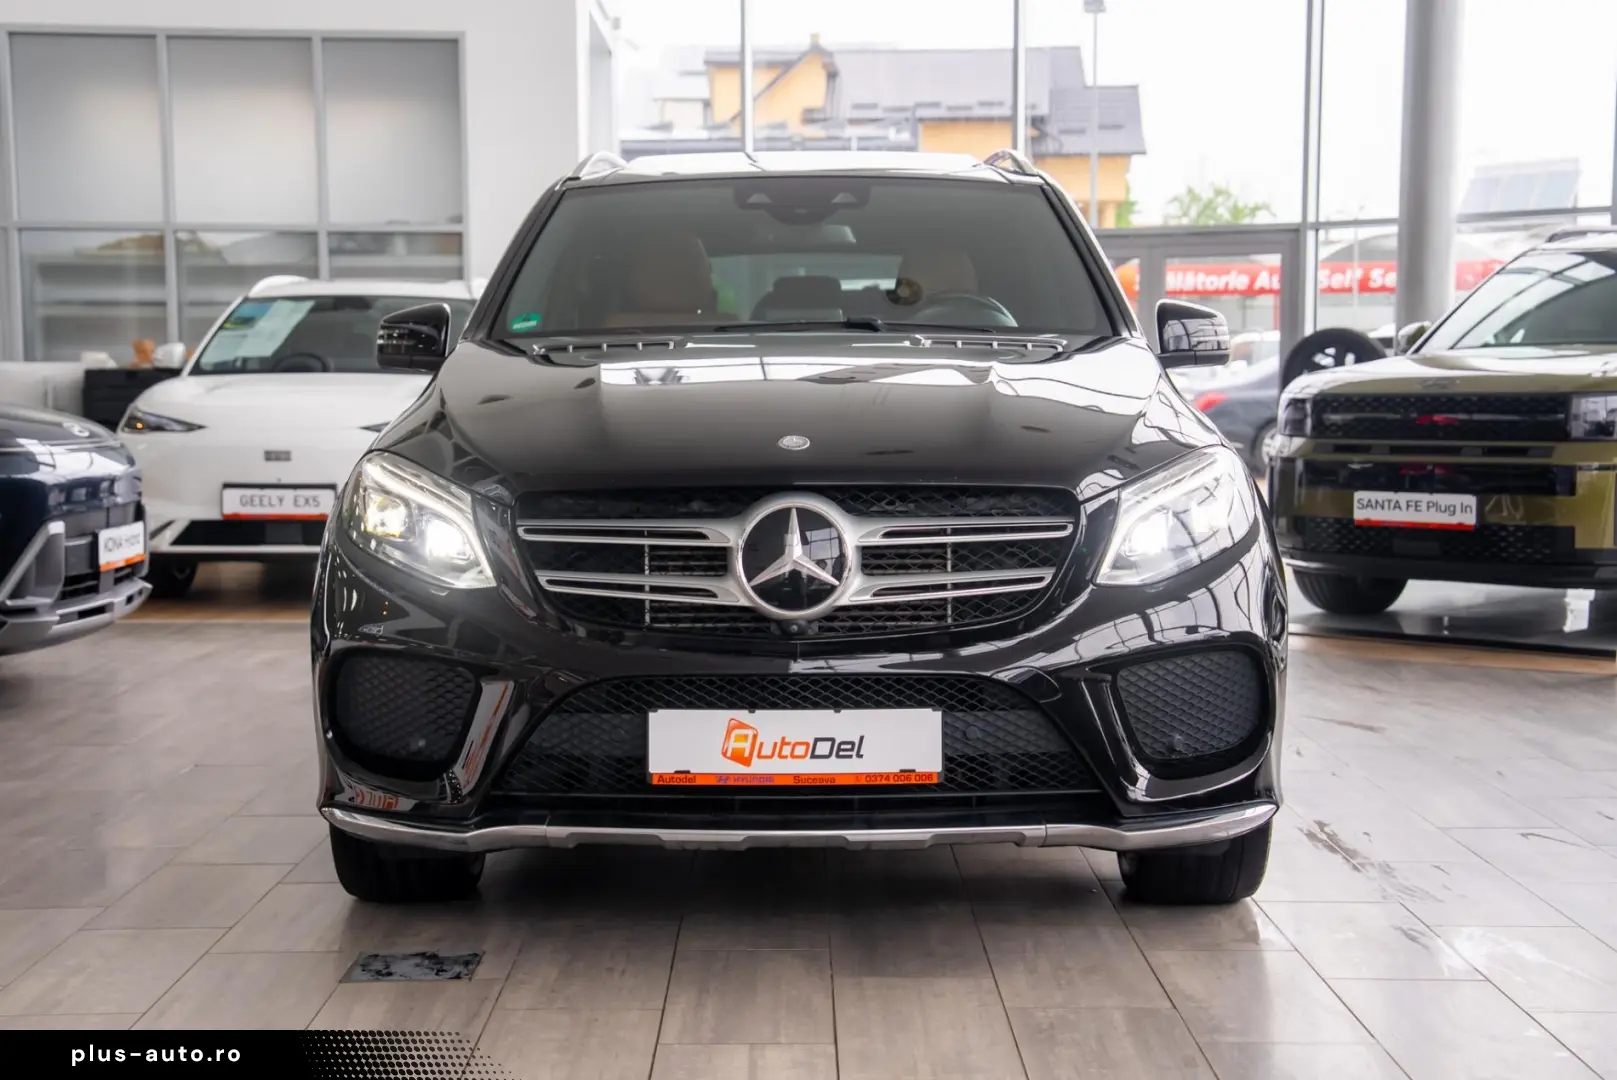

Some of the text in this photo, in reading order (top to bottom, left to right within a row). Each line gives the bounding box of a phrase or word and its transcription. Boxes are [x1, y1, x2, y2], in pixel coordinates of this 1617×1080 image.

[239, 494, 321, 508] GEELY EX5
[1356, 498, 1473, 516] SANTA FE Plug In
[724, 726, 865, 760] AutoDel
[656, 774, 697, 784] Autodel
[793, 775, 836, 784] Suceava
[865, 774, 890, 783] 0374
[893, 774, 912, 783] 006
[914, 773, 934, 782] 006
